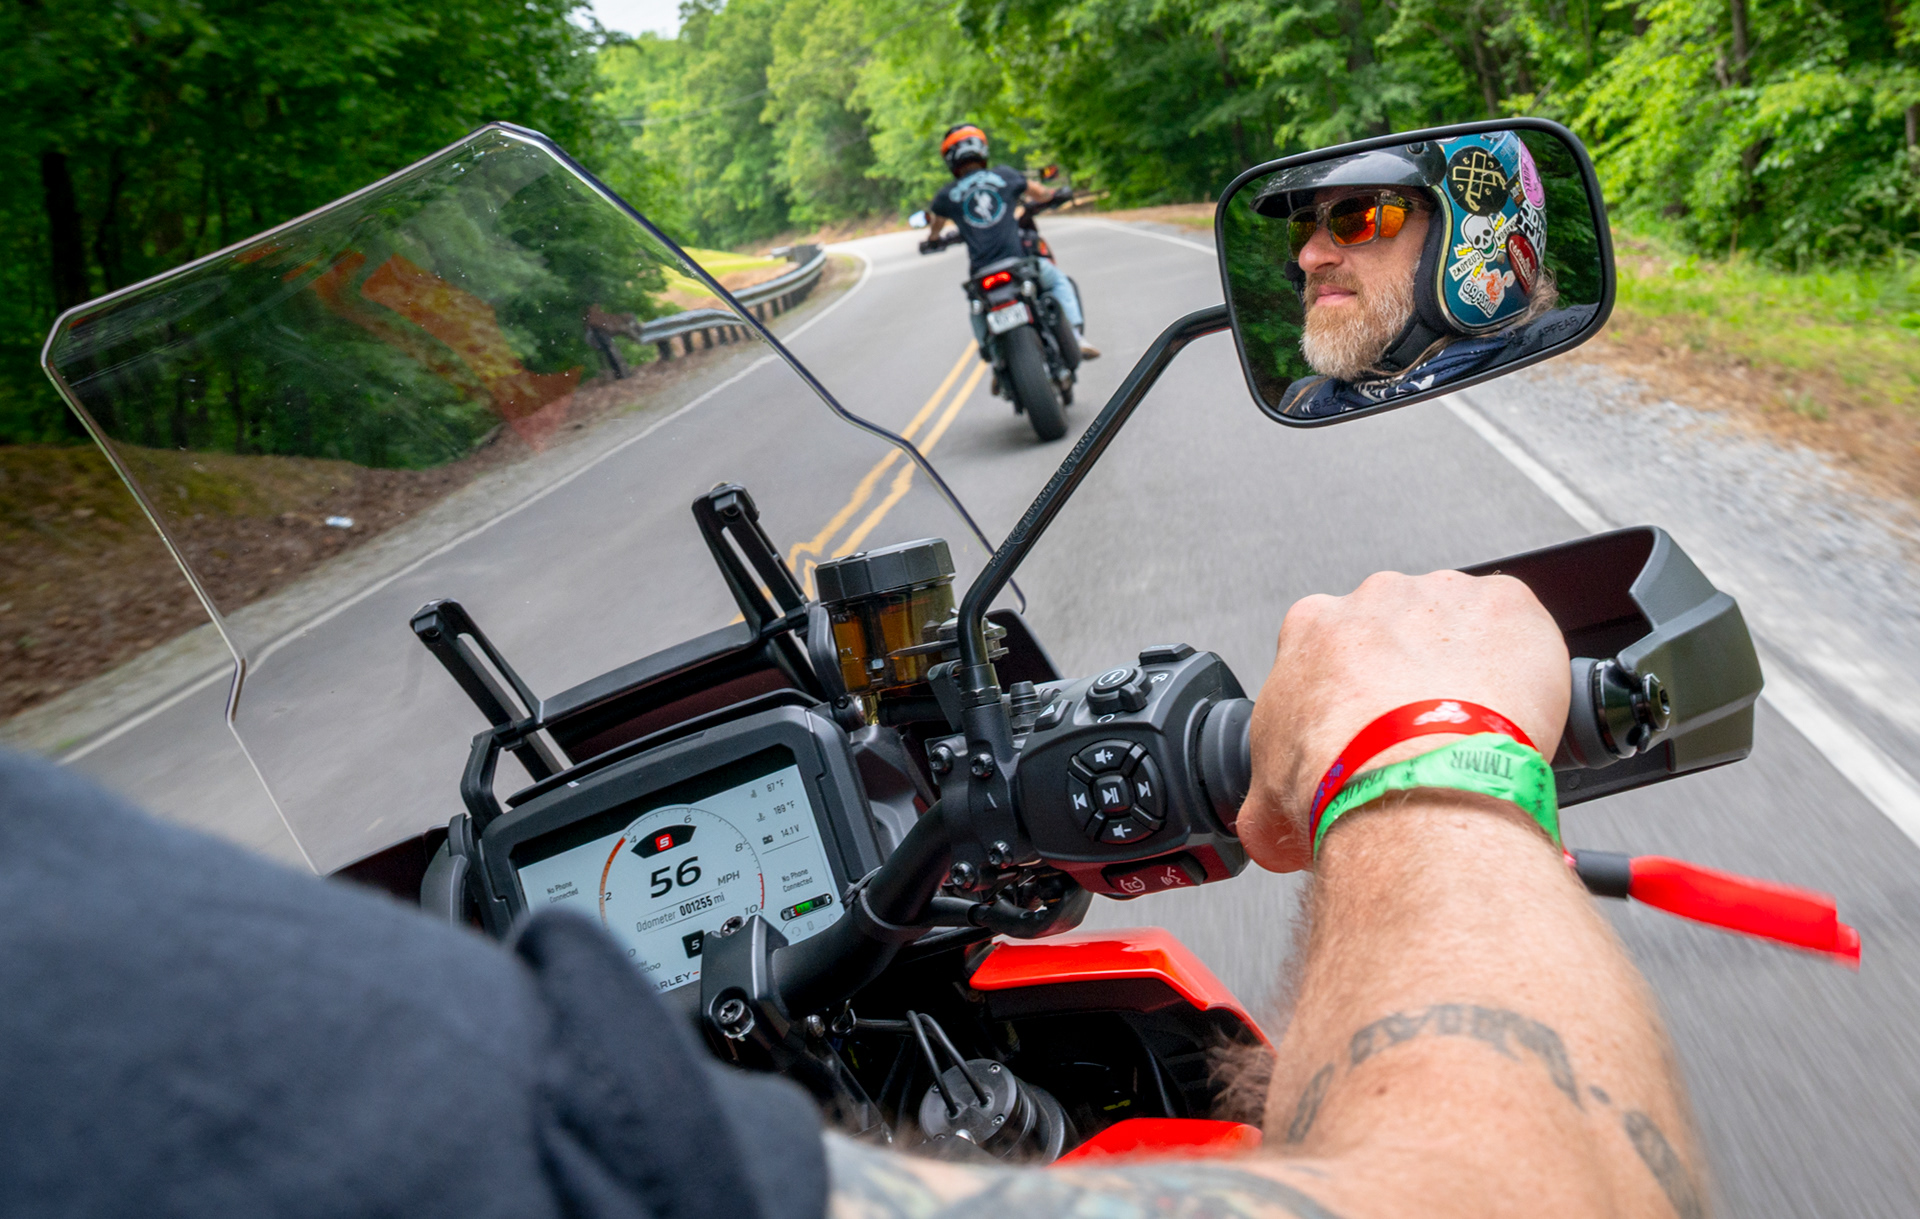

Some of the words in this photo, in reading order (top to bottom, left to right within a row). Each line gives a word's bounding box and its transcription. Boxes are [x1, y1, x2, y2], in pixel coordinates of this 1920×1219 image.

[1538, 316, 1578, 339] APPEAR
[683, 814, 692, 824] 6
[629, 835, 638, 844] 4
[735, 843, 743, 852] 8
[651, 856, 702, 899] 56
[717, 870, 740, 886] MPH
[790, 869, 809, 879] Phone
[547, 887, 555, 895] No
[555, 881, 573, 891] Phone
[782, 876, 814, 893] Connected
[1125, 880, 1141, 890] TC
[549, 888, 579, 903] Connected
[605, 892, 612, 901] 2
[636, 910, 676, 932] Odometer
[679, 895, 713, 916] 001255
[713, 892, 725, 904] mi
[744, 904, 759, 915] 10
[691, 939, 700, 950] 5
